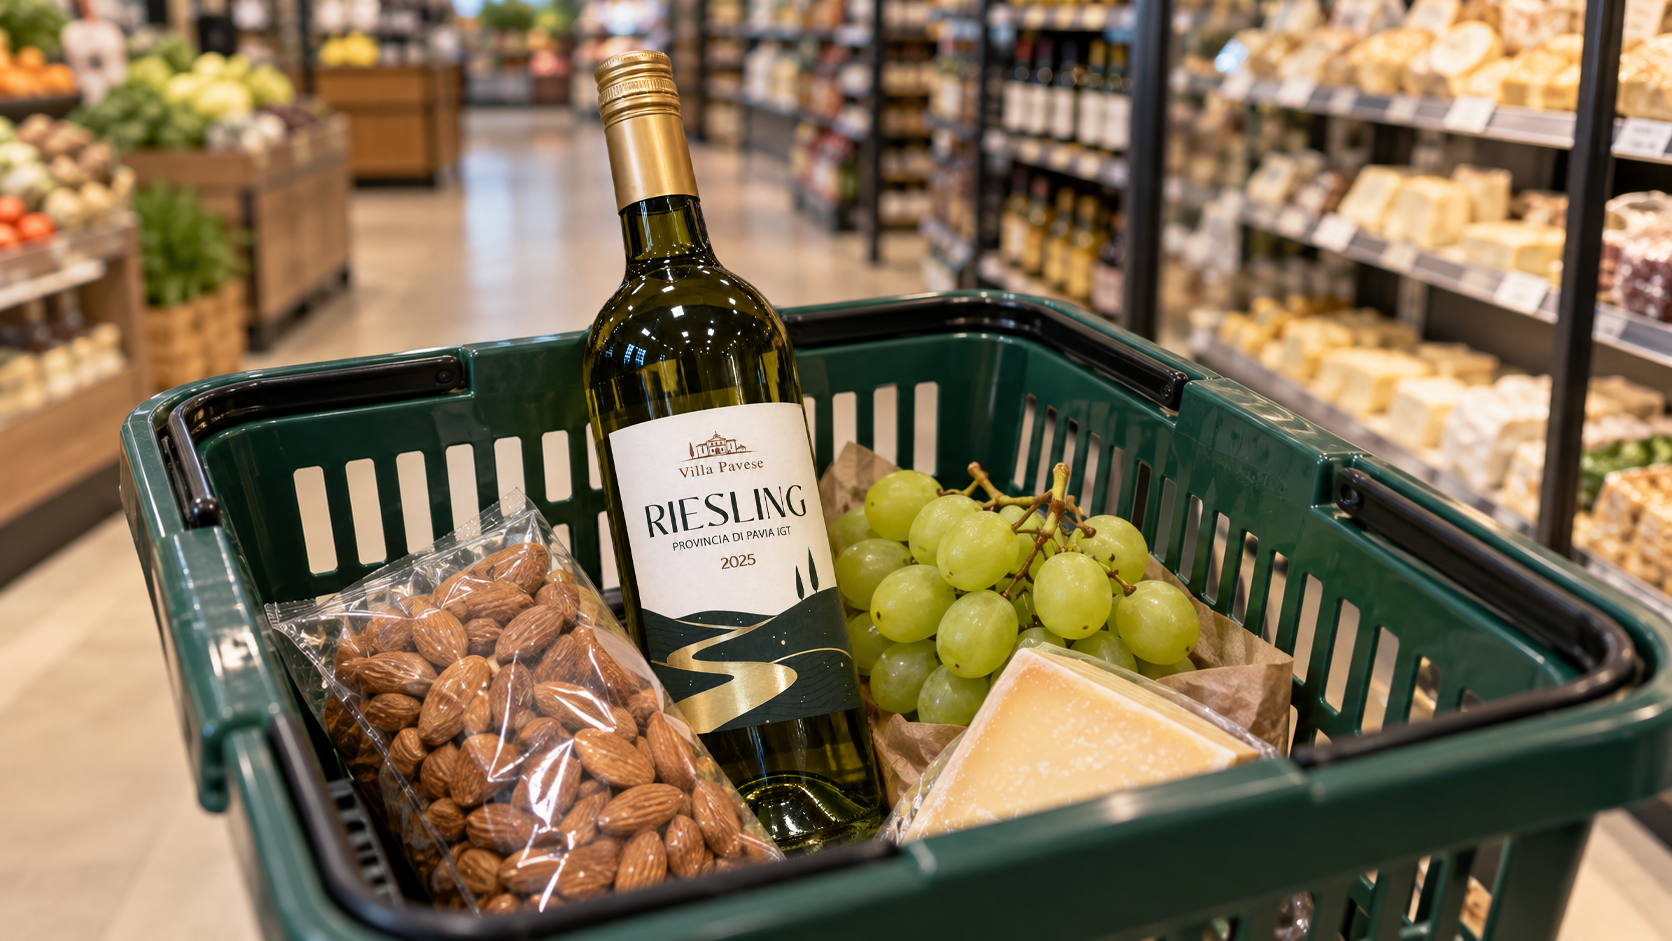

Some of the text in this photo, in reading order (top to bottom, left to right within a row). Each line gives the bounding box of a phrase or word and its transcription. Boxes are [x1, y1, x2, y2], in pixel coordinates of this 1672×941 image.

[679, 459, 764, 478] Villa Pavese
[644, 484, 807, 538] RIESLING
[672, 525, 792, 551] PROVINCIA DI PAVIA IGT
[720, 553, 757, 570] 2025
